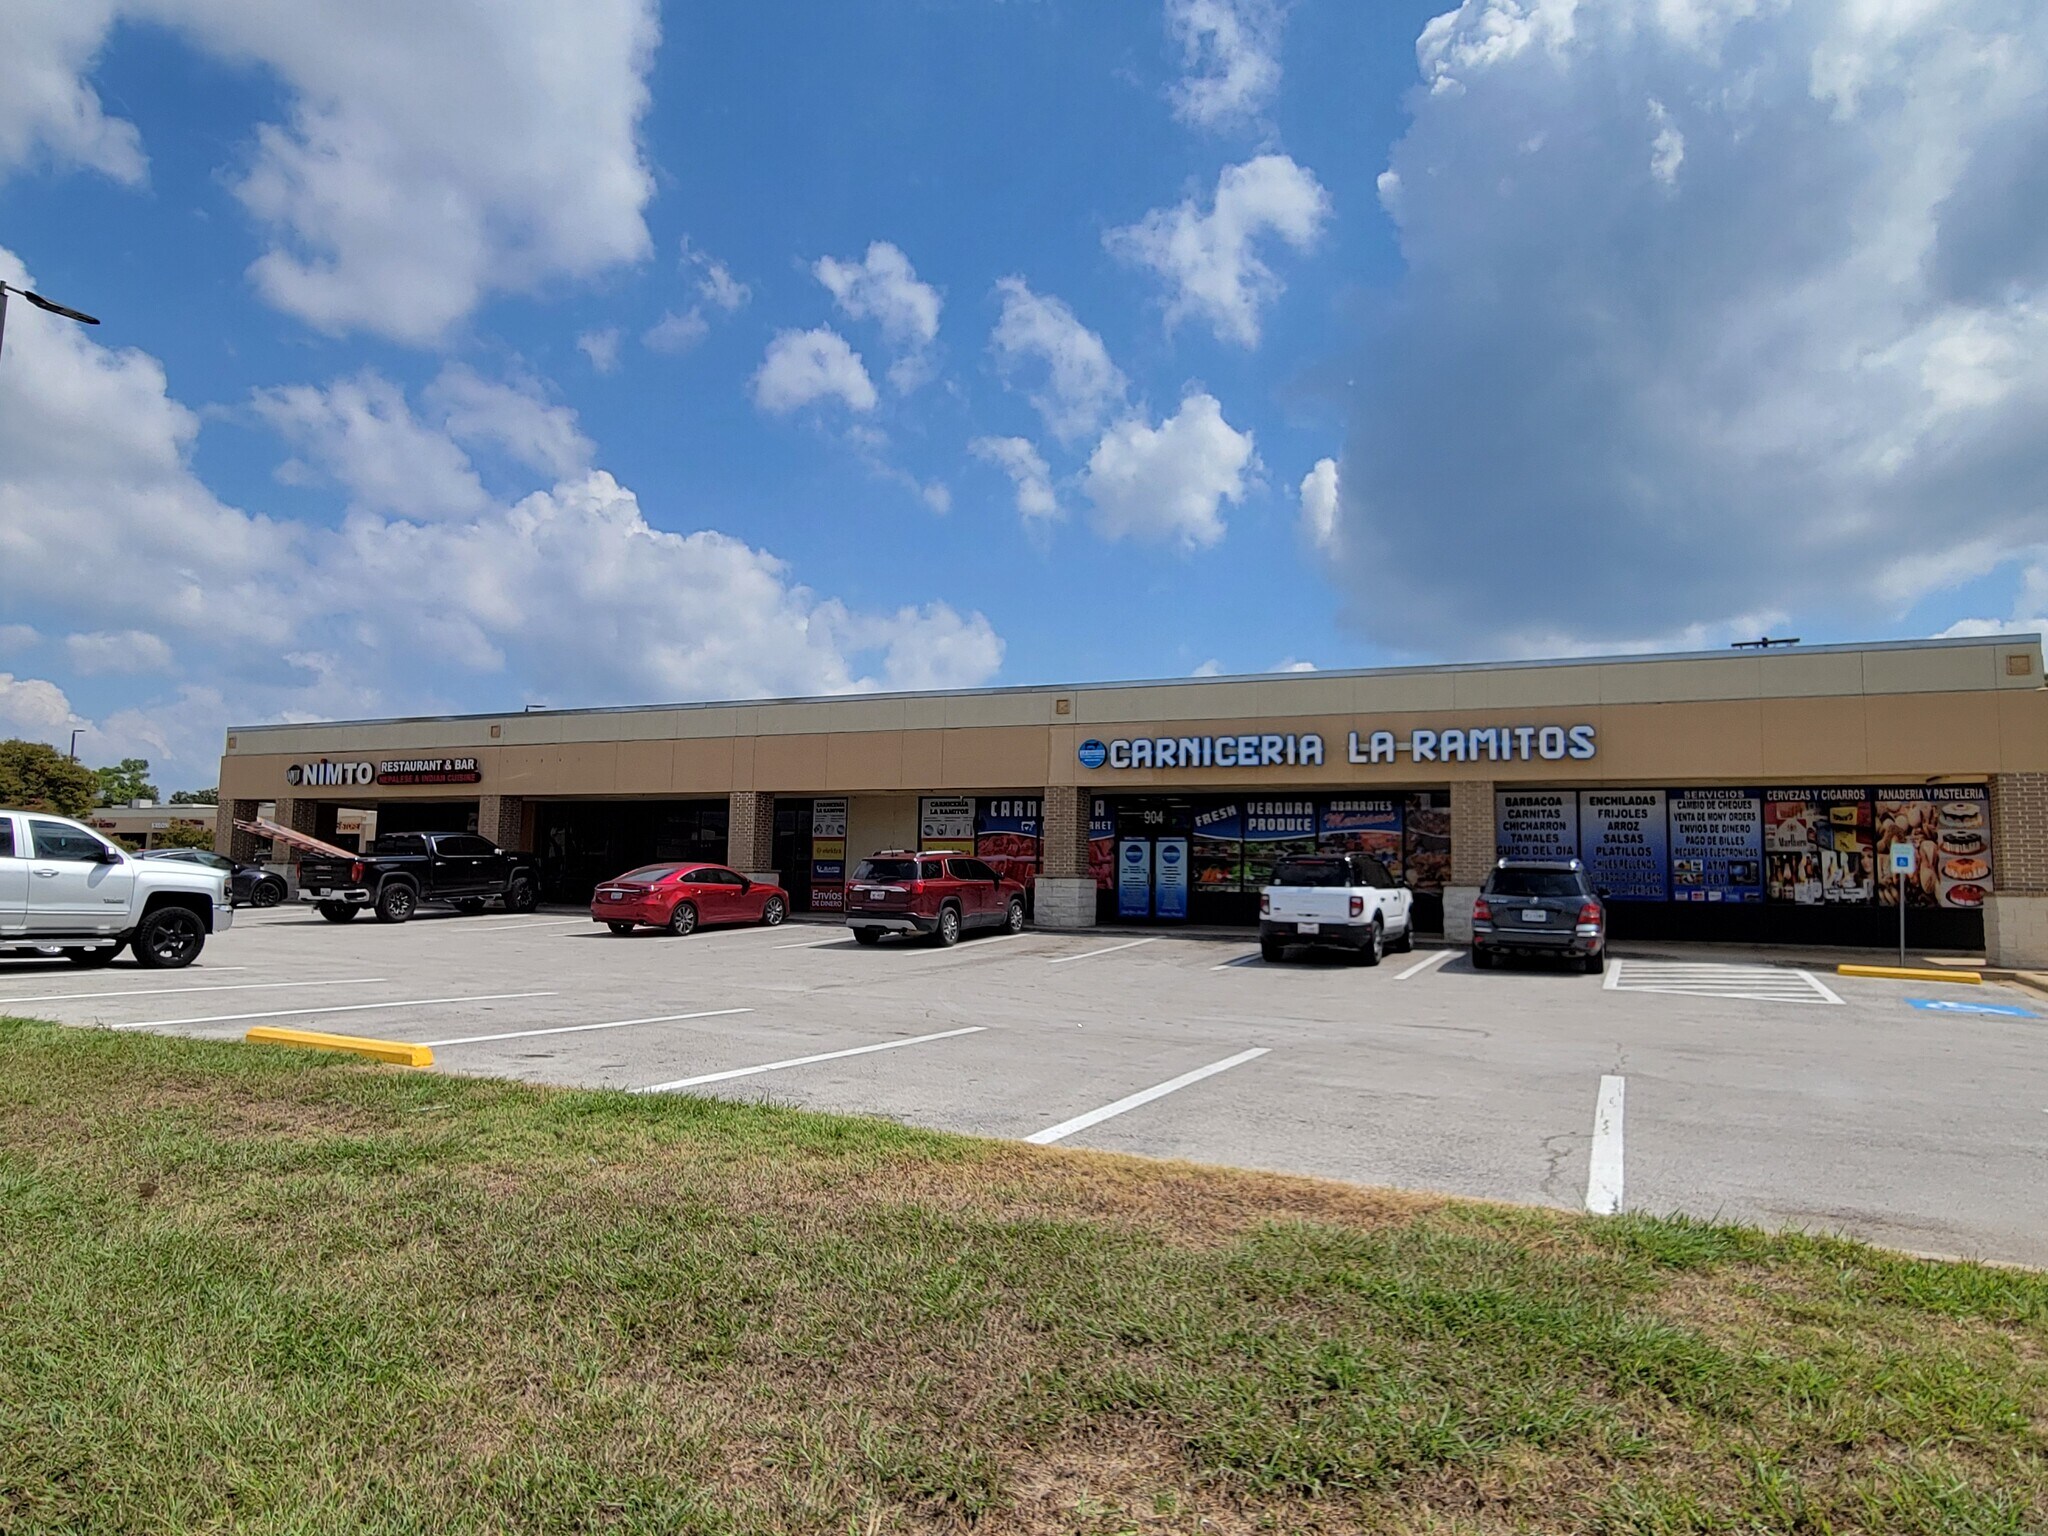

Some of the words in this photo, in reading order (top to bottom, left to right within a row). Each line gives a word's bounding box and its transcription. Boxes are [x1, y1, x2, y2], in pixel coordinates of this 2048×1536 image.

[1109, 733, 1324, 768] CARNICERIA
[1348, 731, 1395, 764] LA
[1412, 725, 1596, 763] RAMITOS
[381, 760, 443, 772] RESTAURANT
[444, 759, 452, 771] &
[454, 758, 475, 770] BAR
[379, 774, 414, 784] NEPALESE
[421, 774, 446, 783] INDIAN
[447, 773, 476, 782] CUISINE
[1683, 789, 1745, 799] SERVICIOS
[1766, 790, 1811, 801] CERVEZAS
[1813, 789, 1819, 801] Y
[1821, 789, 1866, 801] CIGARROS
[1878, 788, 1924, 800] PANADERIA
[1925, 788, 1932, 800] Y
[1933, 787, 1985, 800] PASTELERIA
[1330, 800, 1392, 811] ABARROTES
[1504, 797, 1562, 807] BARBACOA
[1589, 796, 1656, 806] ENCHILADAS
[1677, 801, 1705, 809] CAMBIO
[1707, 801, 1716, 809] DE
[1718, 800, 1752, 809] CHEQUES
[1247, 801, 1314, 815] VERDURA
[1143, 810, 1164, 825] 904
[1195, 804, 1238, 828] FRESH
[1507, 809, 1561, 819] CARNITAS
[1598, 809, 1648, 818] FRIJOLES
[1674, 813, 1695, 821] VENTA
[1697, 813, 1706, 821] DE
[1707, 813, 1727, 821] MONY
[1729, 812, 1756, 821] ORDERS
[1248, 817, 1312, 832] PRODUCE
[1503, 821, 1566, 831] CHICHARRON
[1607, 821, 1640, 831] ARROZ
[1680, 824, 1707, 833] ENVIOS
[1710, 824, 1719, 833] DE
[1722, 824, 1751, 833] DINERO
[1510, 833, 1559, 843] TAMALES
[1603, 834, 1644, 844] SALSAS
[1686, 836, 1705, 845] PAGO
[1707, 836, 1717, 845] DE
[1719, 836, 1745, 845] BILLES
[1496, 845, 1529, 855] GUISO
[1532, 846, 1552, 855] DEL
[1556, 846, 1574, 855] DIA
[1596, 846, 1652, 856] PLATILLOS
[1707, 861, 1726, 870] ATM
[812, 888, 842, 901] Envíos
